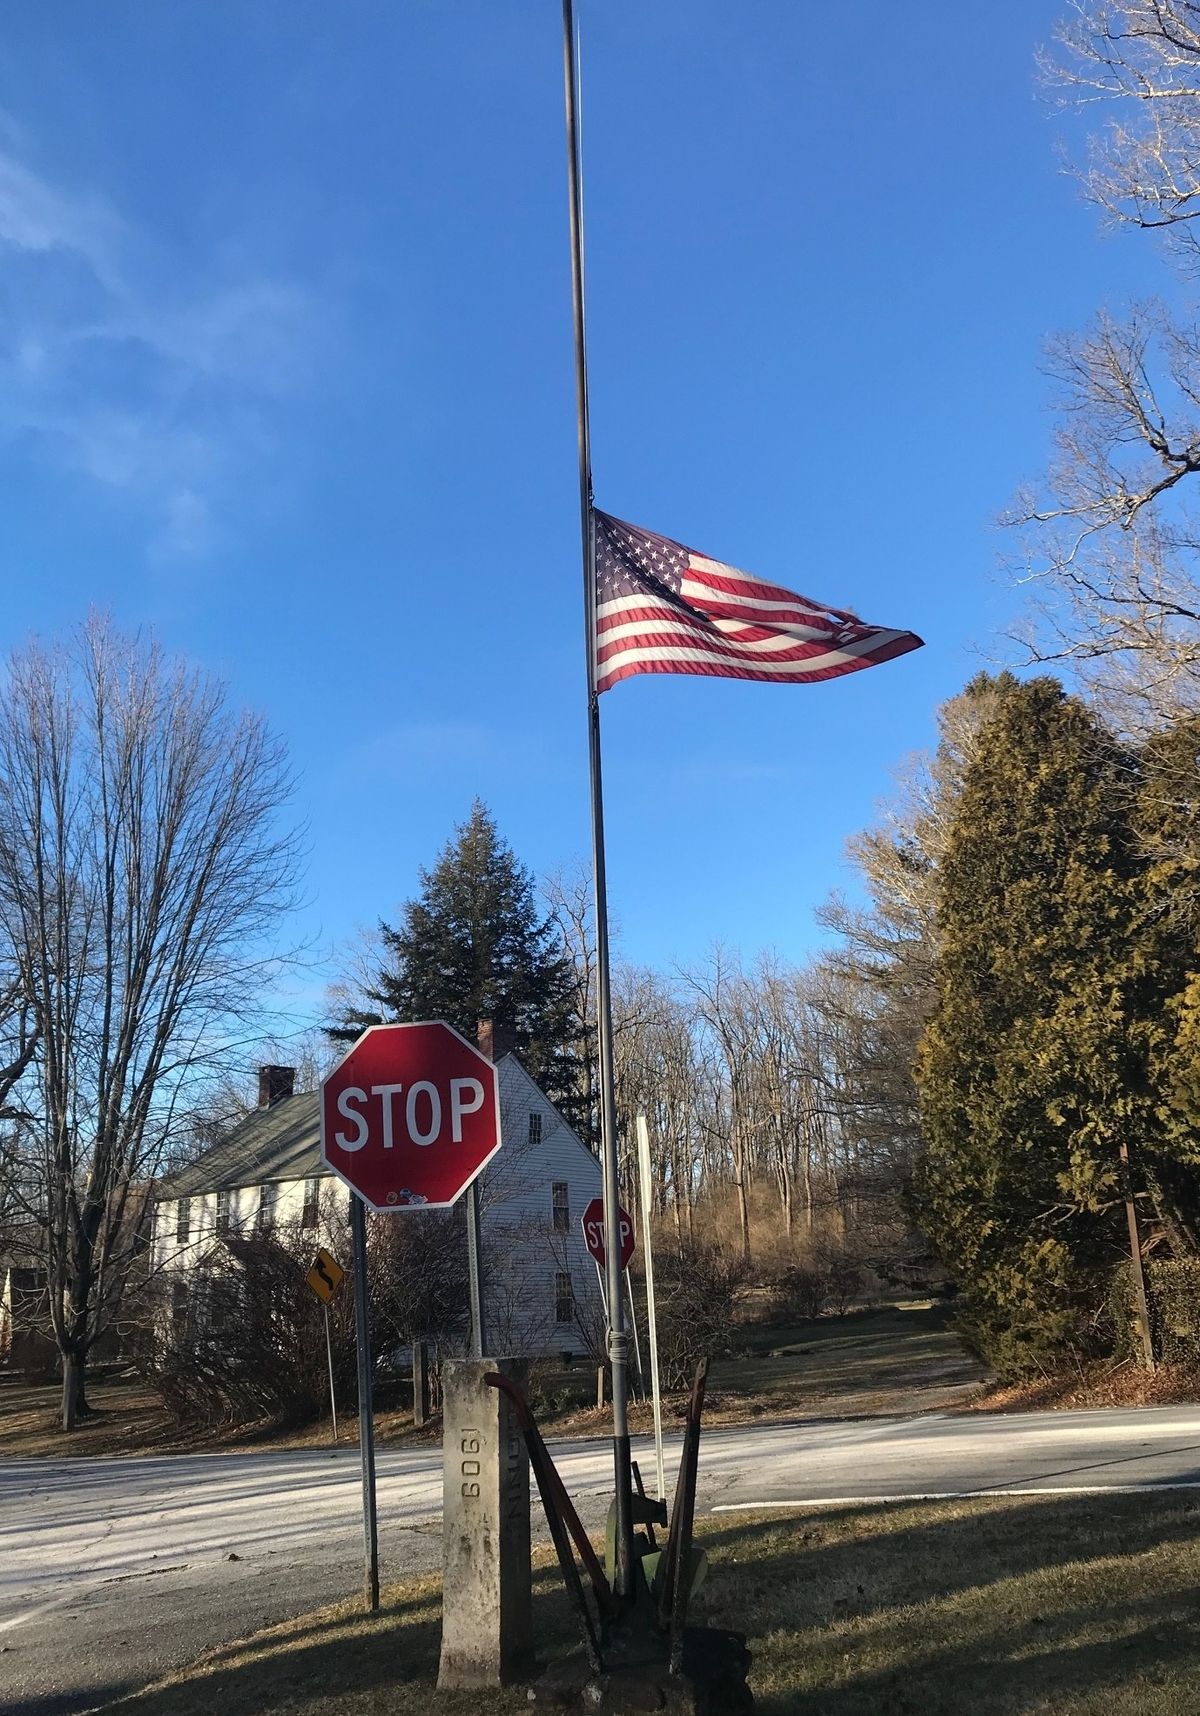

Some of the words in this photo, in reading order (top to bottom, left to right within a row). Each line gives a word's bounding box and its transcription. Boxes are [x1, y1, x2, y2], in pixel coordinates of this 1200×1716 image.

[334, 1077, 485, 1152] STOP
[587, 1220, 630, 1249] STP
[461, 1428, 480, 1498] 1909
